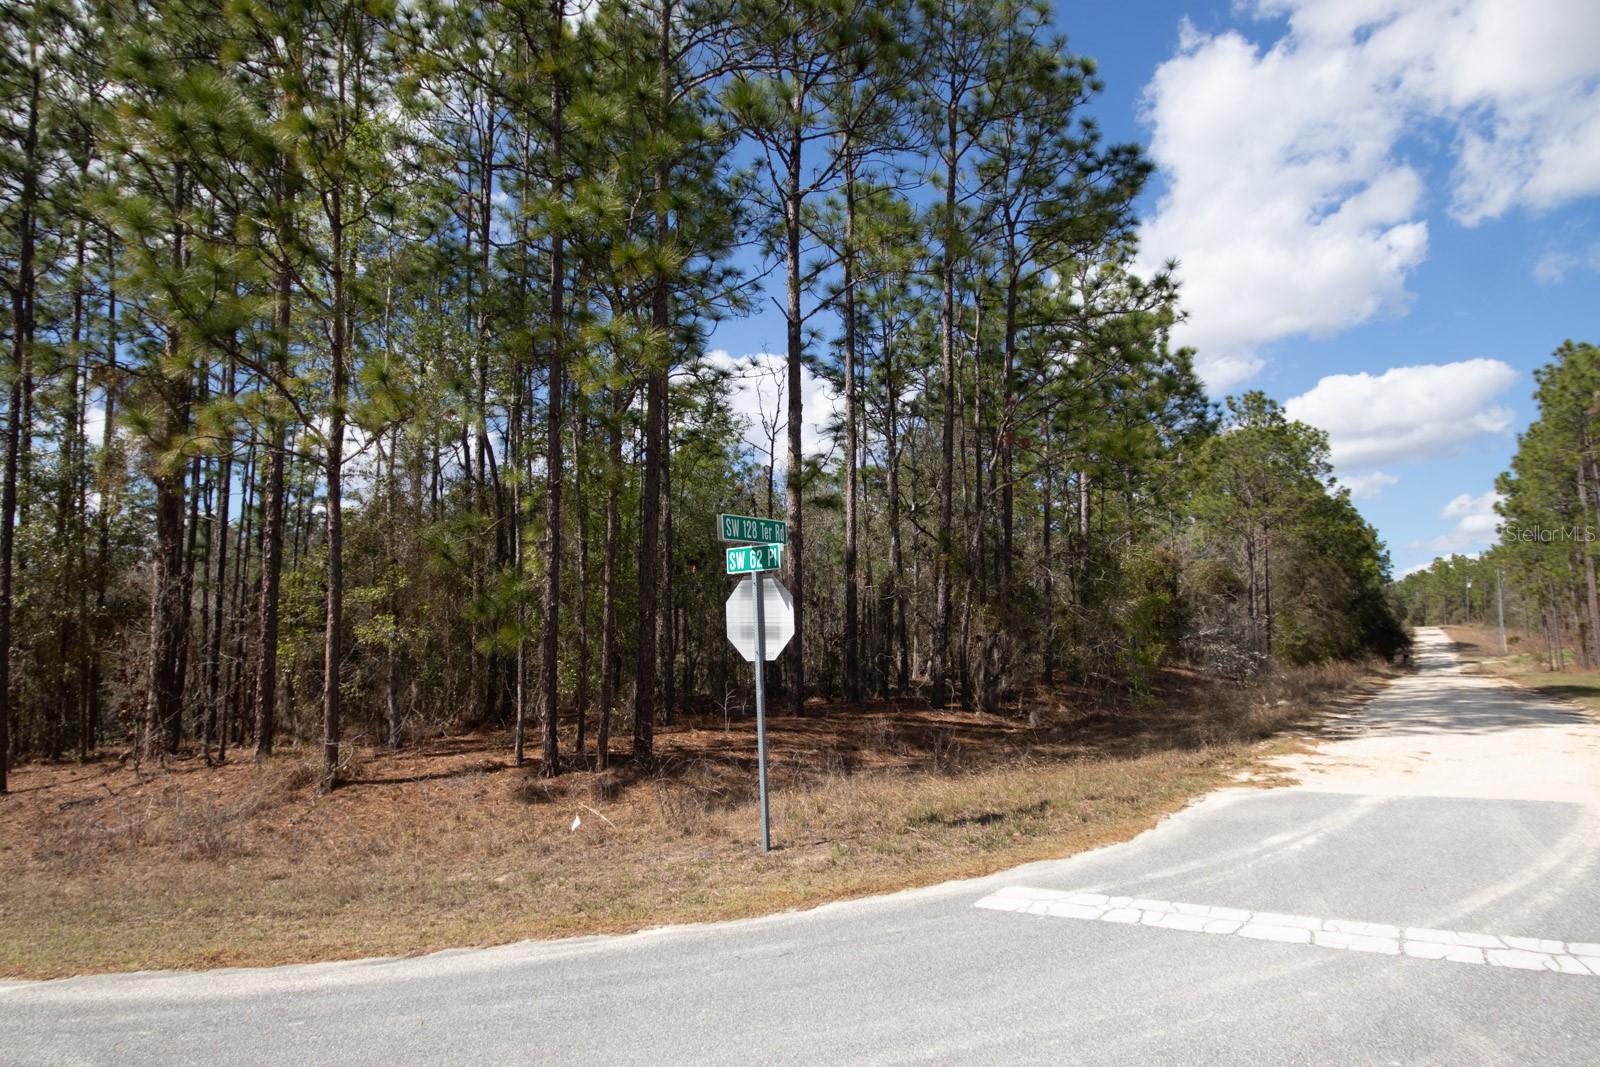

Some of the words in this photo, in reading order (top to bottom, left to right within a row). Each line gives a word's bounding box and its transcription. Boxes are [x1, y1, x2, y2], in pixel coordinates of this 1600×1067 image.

[726, 518, 739, 536] SW
[743, 520, 757, 539] 128
[760, 522, 772, 540] Ter
[775, 524, 784, 541] Rd
[729, 551, 745, 570] SW
[749, 549, 762, 568] 62
[767, 547, 777, 566] Pl
